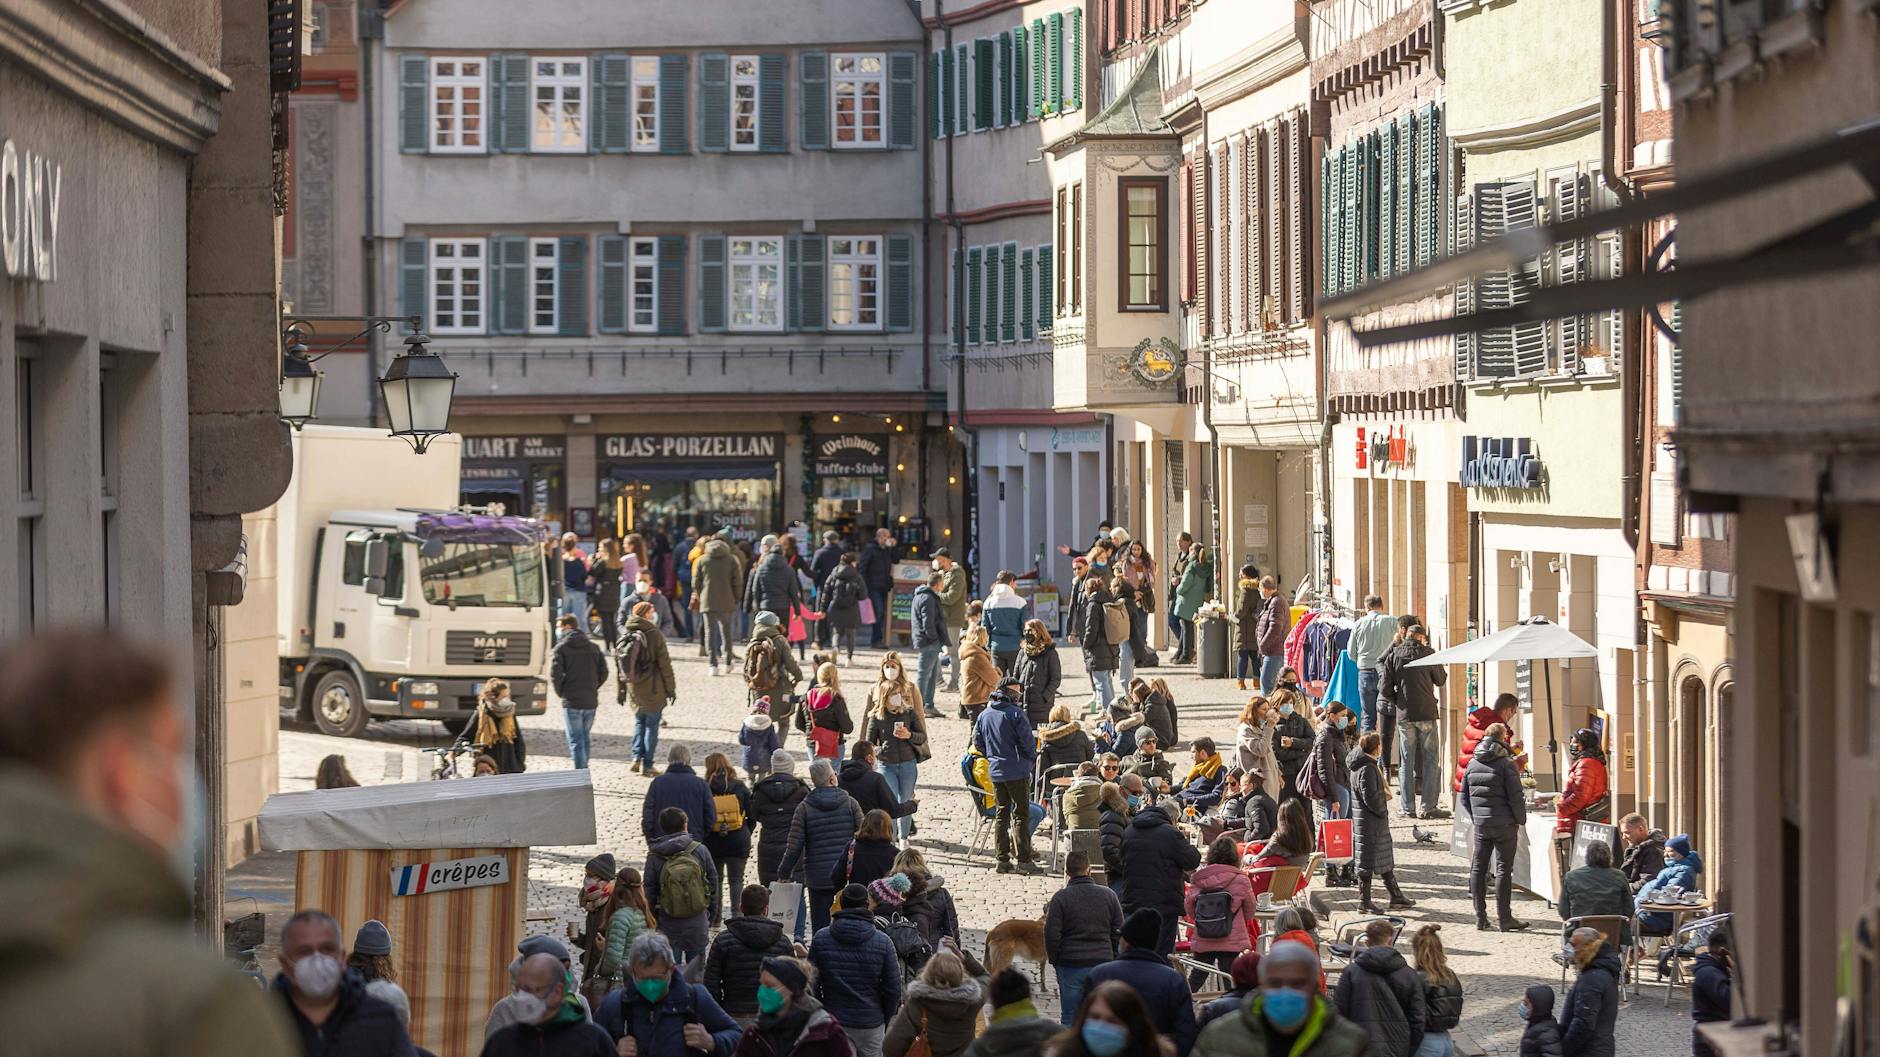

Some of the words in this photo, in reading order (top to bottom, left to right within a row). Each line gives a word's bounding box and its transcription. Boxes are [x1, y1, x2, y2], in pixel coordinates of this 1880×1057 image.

[2, 139, 61, 281] ONLY
[605, 437, 775, 457] GLAS-PORZELLAN
[728, 526, 758, 543] hop
[473, 637, 508, 649] MAN
[431, 862, 501, 885] crêpes
